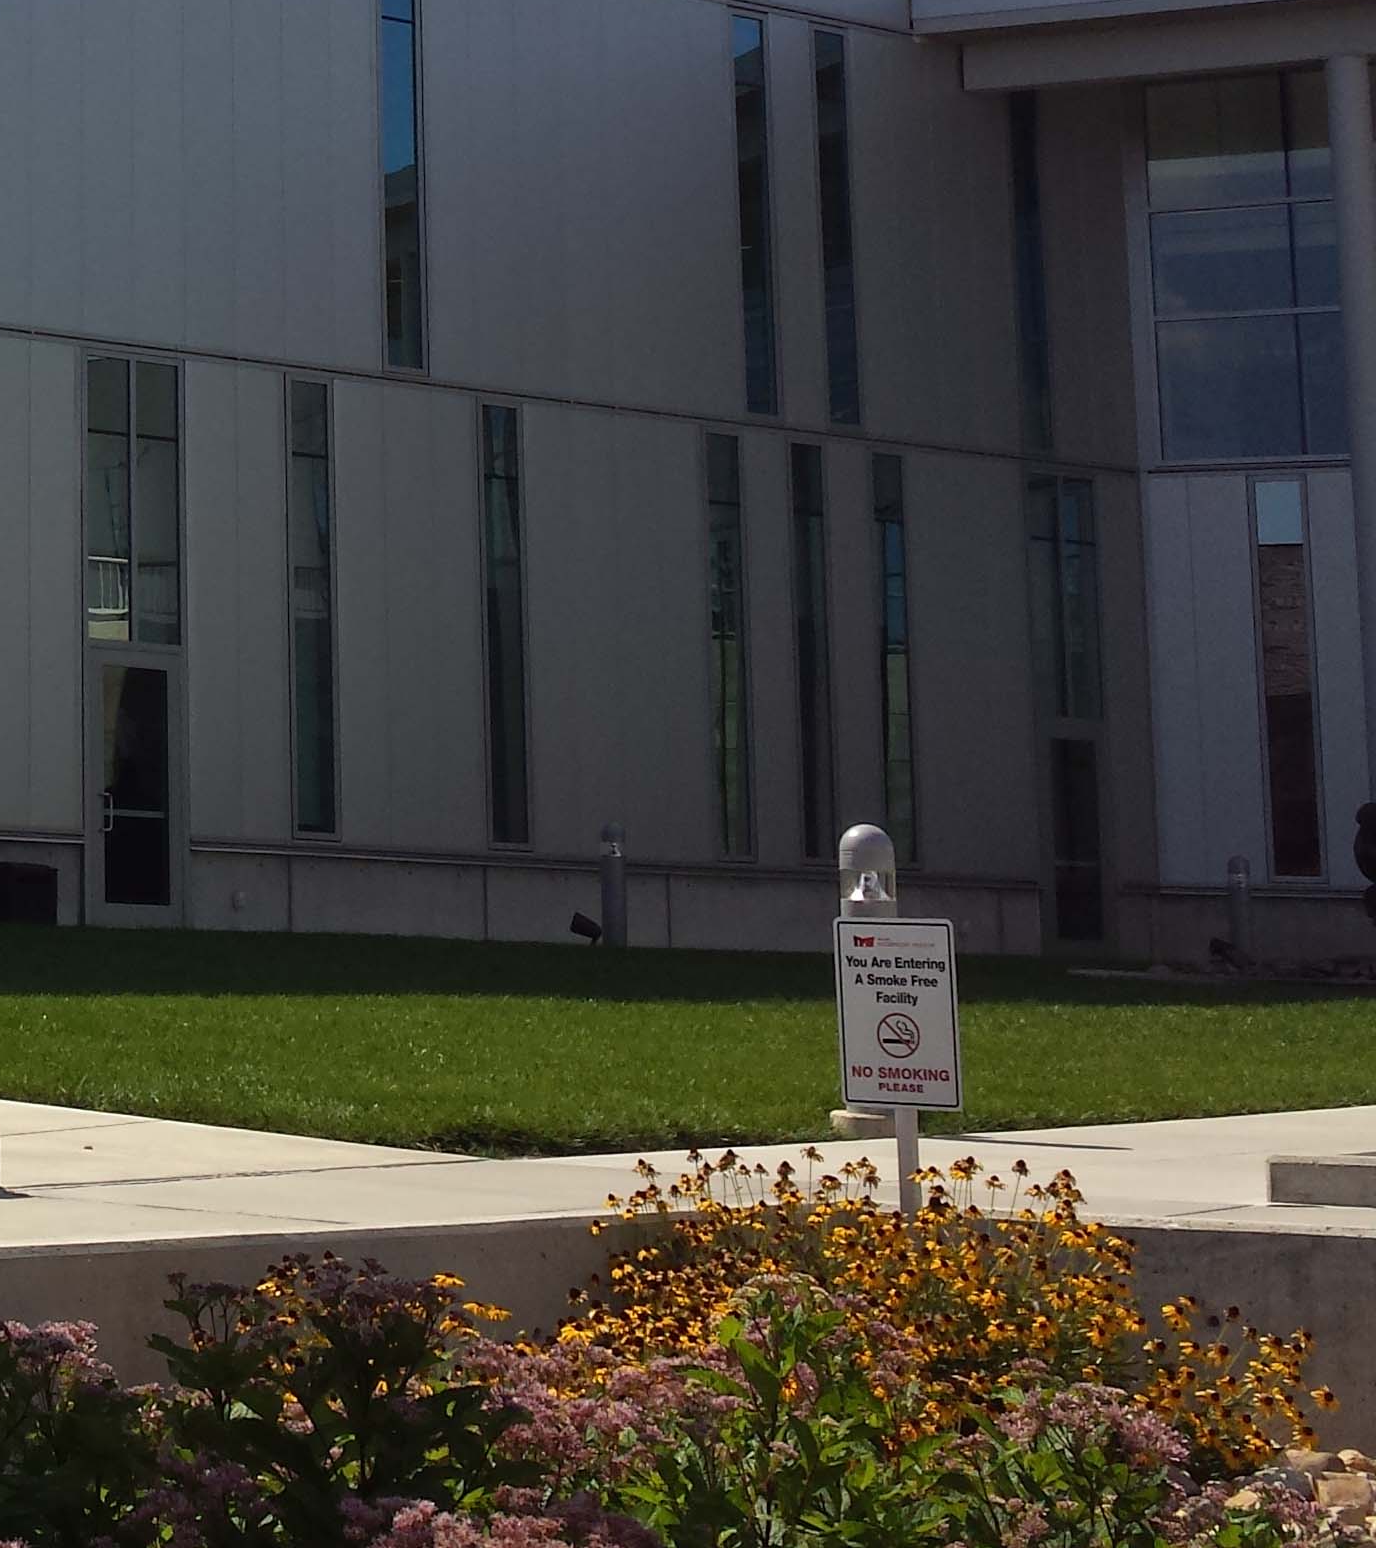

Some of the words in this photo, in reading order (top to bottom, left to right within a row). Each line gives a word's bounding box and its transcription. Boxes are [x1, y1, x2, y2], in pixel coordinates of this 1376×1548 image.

[846, 955, 867, 968] You
[871, 956, 892, 969] Are
[894, 957, 946, 973] Entering
[855, 973, 864, 985] A
[867, 973, 908, 987] Smoke
[911, 975, 938, 988] Free
[876, 991, 919, 1007] Facility
[851, 1065, 873, 1078] NO
[878, 1066, 950, 1082] SMOKING
[878, 1082, 925, 1094] PLEASE
